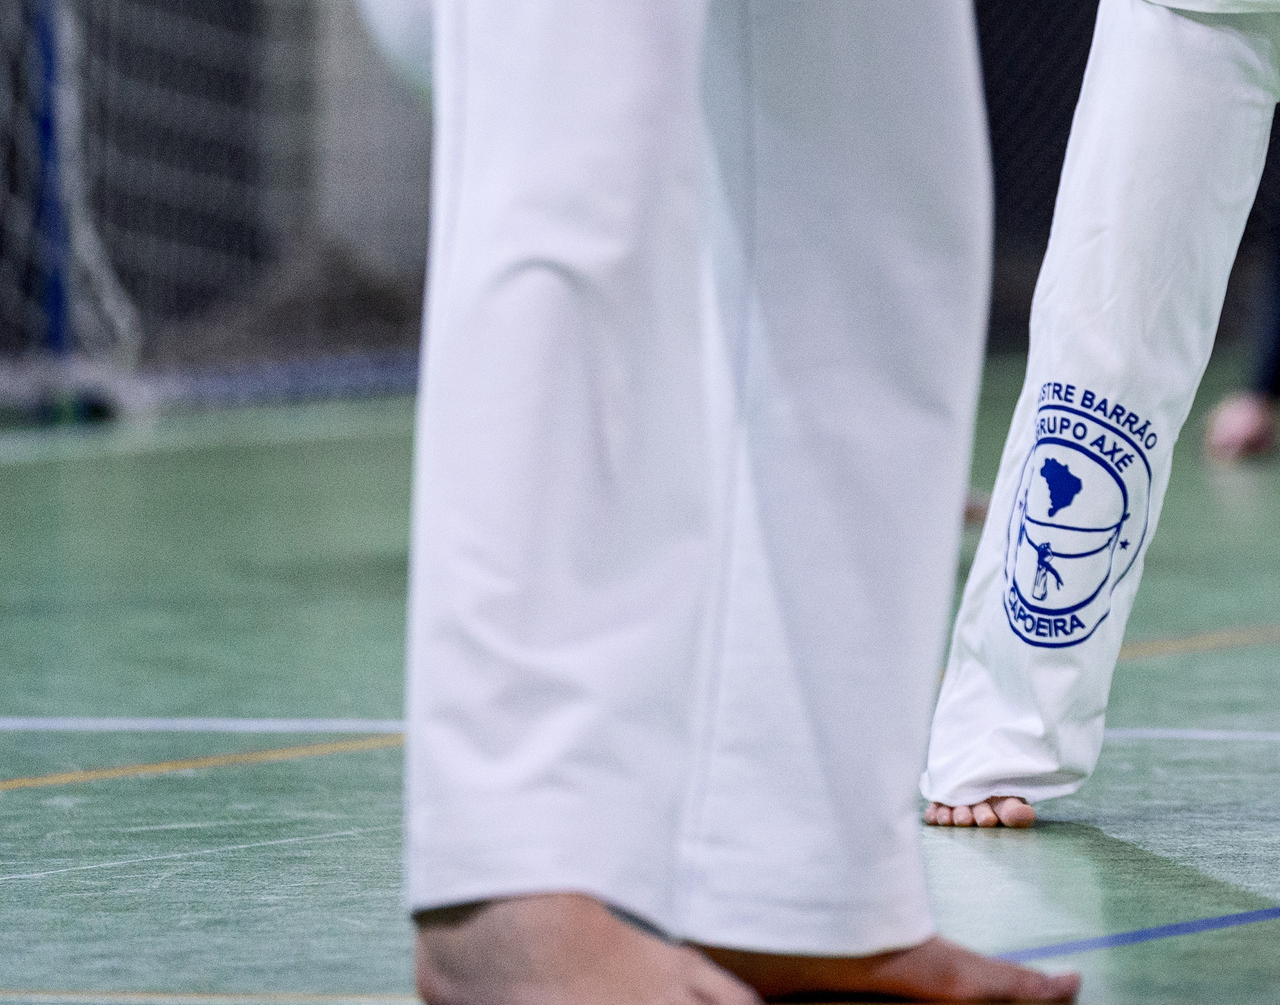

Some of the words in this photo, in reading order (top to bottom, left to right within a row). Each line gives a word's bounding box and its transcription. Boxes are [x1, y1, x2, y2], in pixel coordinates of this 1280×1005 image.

[1080, 389, 1158, 450] BARRÃO
[1089, 434, 1135, 473] AXÉ
[1008, 586, 1086, 638] CAPOEIRA
